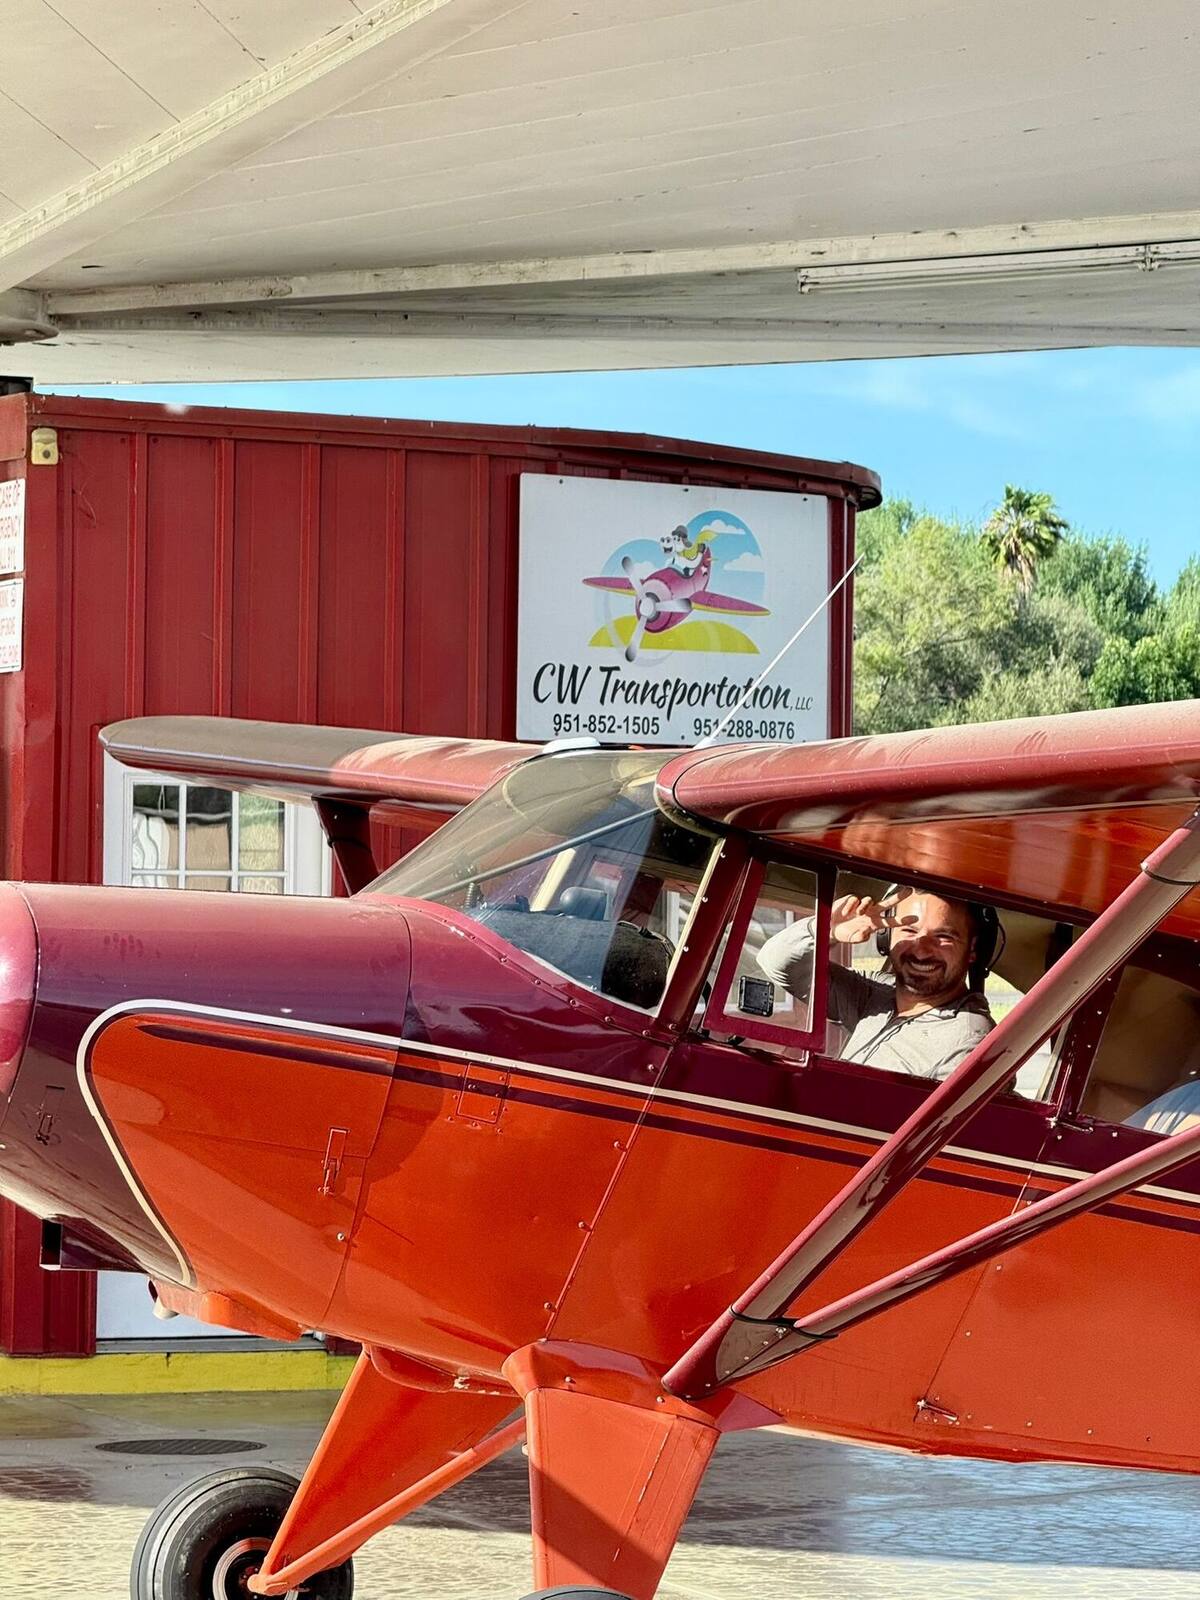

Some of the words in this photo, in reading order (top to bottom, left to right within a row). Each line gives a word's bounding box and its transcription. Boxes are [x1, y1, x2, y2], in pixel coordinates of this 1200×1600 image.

[533, 662, 592, 705] CW
[795, 696, 813, 711] LLC
[553, 714, 660, 735] 951-852-1505
[693, 718, 795, 740] 951-288-0876
